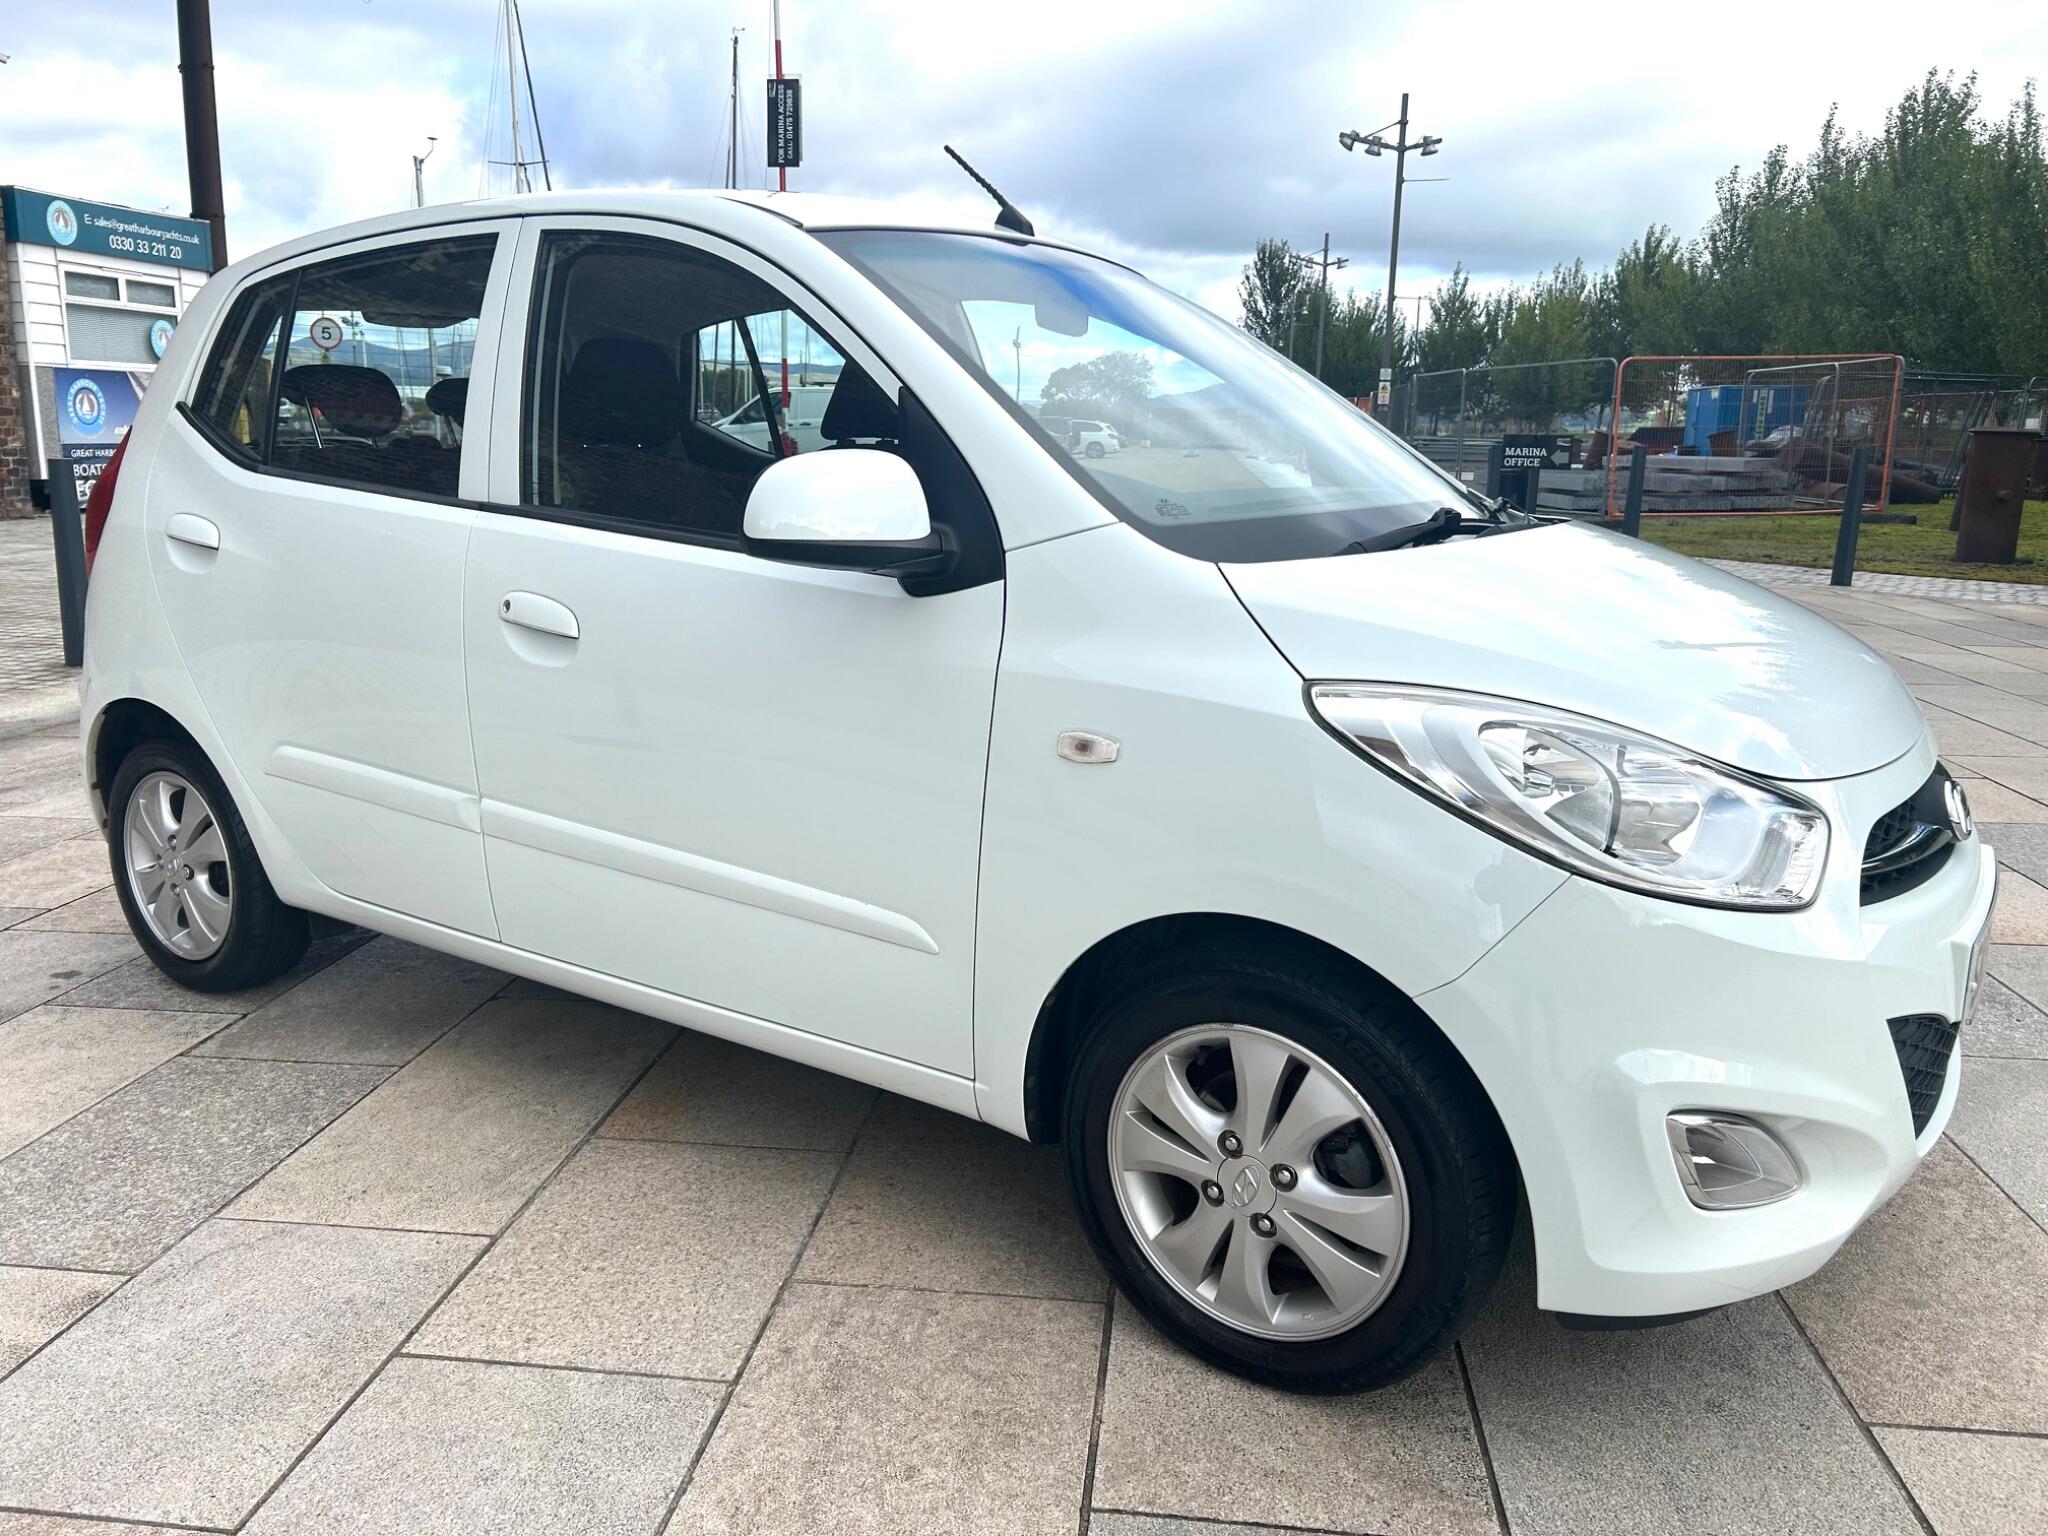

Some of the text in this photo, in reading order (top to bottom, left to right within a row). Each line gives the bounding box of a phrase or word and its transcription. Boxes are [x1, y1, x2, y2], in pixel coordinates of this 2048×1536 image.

[93, 215, 200, 245] sales@greatharbouryachts.co.uk
[109, 235, 182, 260] 0330 33 211 20
[321, 326, 332, 341] 5
[70, 448, 94, 458] GREAT
[1505, 447, 1547, 457] MARINA
[1504, 457, 1540, 467] OFFICE
